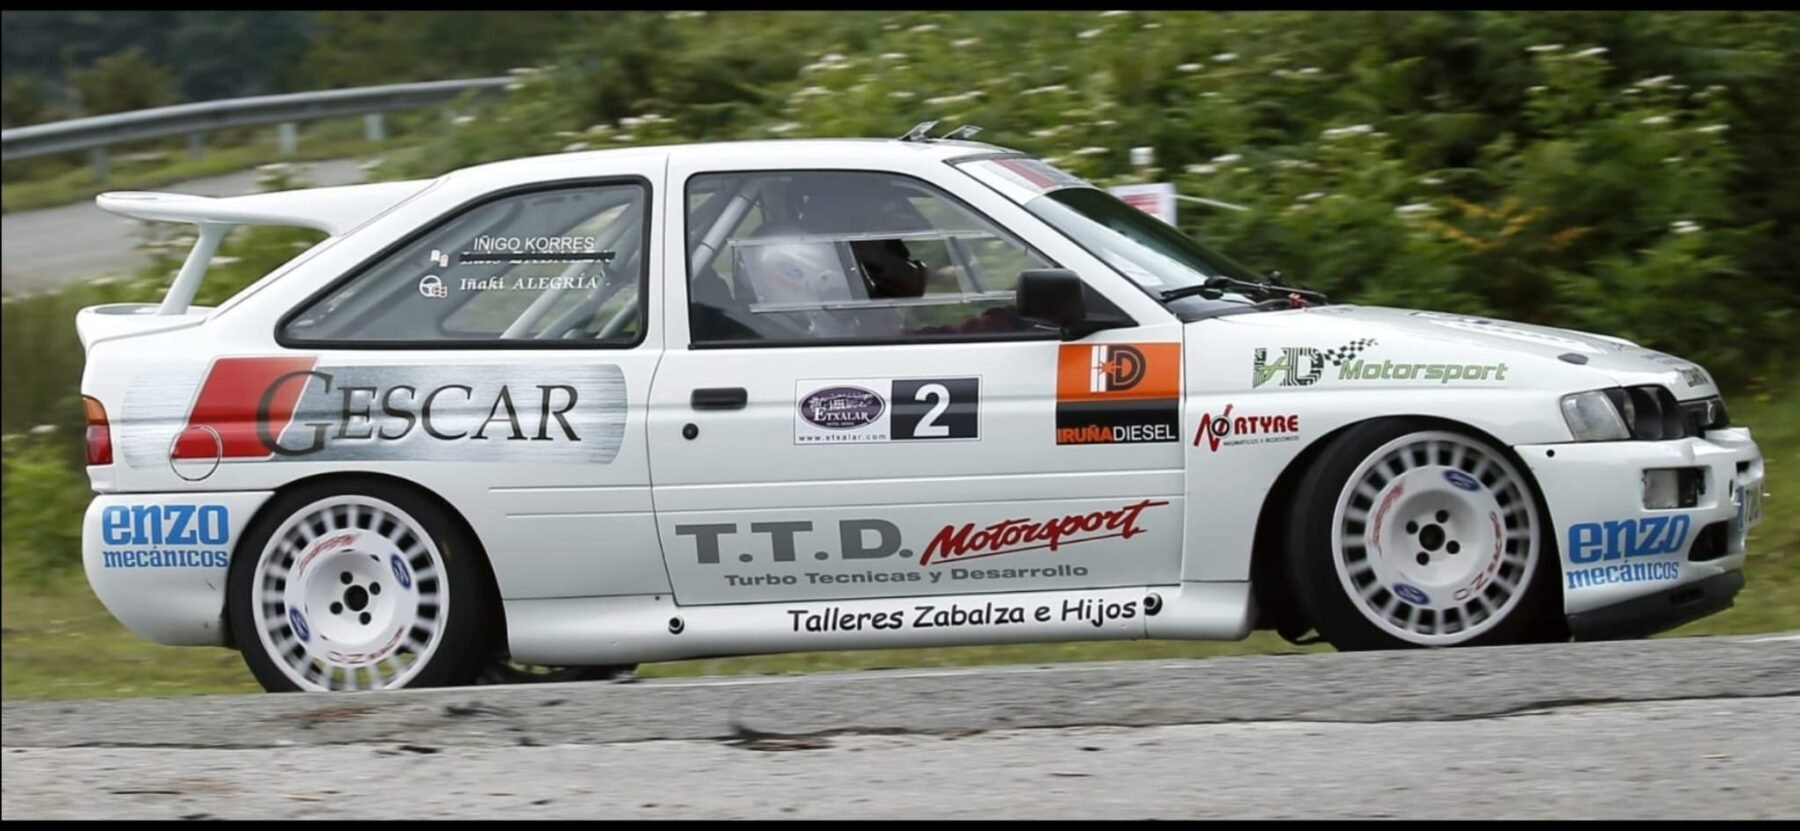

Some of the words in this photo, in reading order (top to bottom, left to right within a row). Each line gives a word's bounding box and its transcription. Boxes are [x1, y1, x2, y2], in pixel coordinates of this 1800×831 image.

[474, 235, 520, 250] IÑIGO
[525, 236, 596, 250] KORRES
[460, 275, 504, 290] Iñaki
[512, 272, 599, 289] ALEGRÍA
[1338, 359, 1508, 384] Motorsport
[256, 370, 581, 456] GESCAR
[913, 383, 950, 437] 2
[799, 433, 887, 442] www.etxalar.com
[102, 505, 229, 545] enzo
[675, 519, 914, 564] T.T.D.
[919, 499, 1169, 566] Motorsport
[1568, 514, 1690, 564] enzo
[102, 546, 228, 567] mecánicos
[724, 573, 798, 587] Turbo
[804, 570, 922, 584] Tecnicas
[929, 571, 943, 583] y
[951, 564, 1089, 581] Desarrollo
[1566, 559, 1680, 588] mecánicos
[787, 606, 904, 632] Talleres
[912, 602, 1026, 628] Zabalza
[1034, 605, 1051, 622] e
[1061, 598, 1138, 628] Hijos
